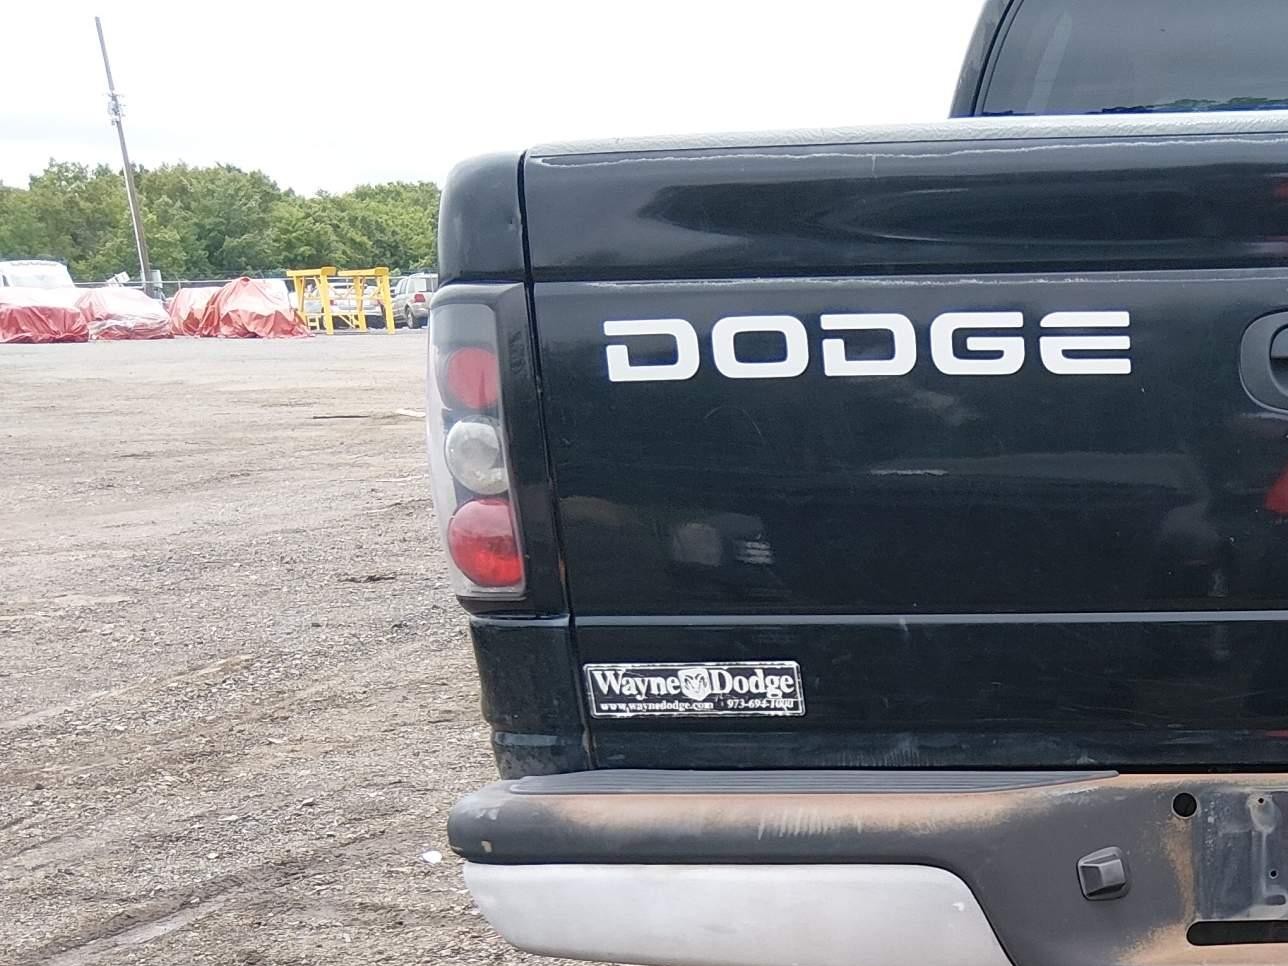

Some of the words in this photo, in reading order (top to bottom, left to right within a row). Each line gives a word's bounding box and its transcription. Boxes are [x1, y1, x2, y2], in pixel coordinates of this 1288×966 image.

[603, 311, 1132, 382] DODGE
[592, 669, 681, 700] Wayne
[709, 668, 795, 699] Dodge
